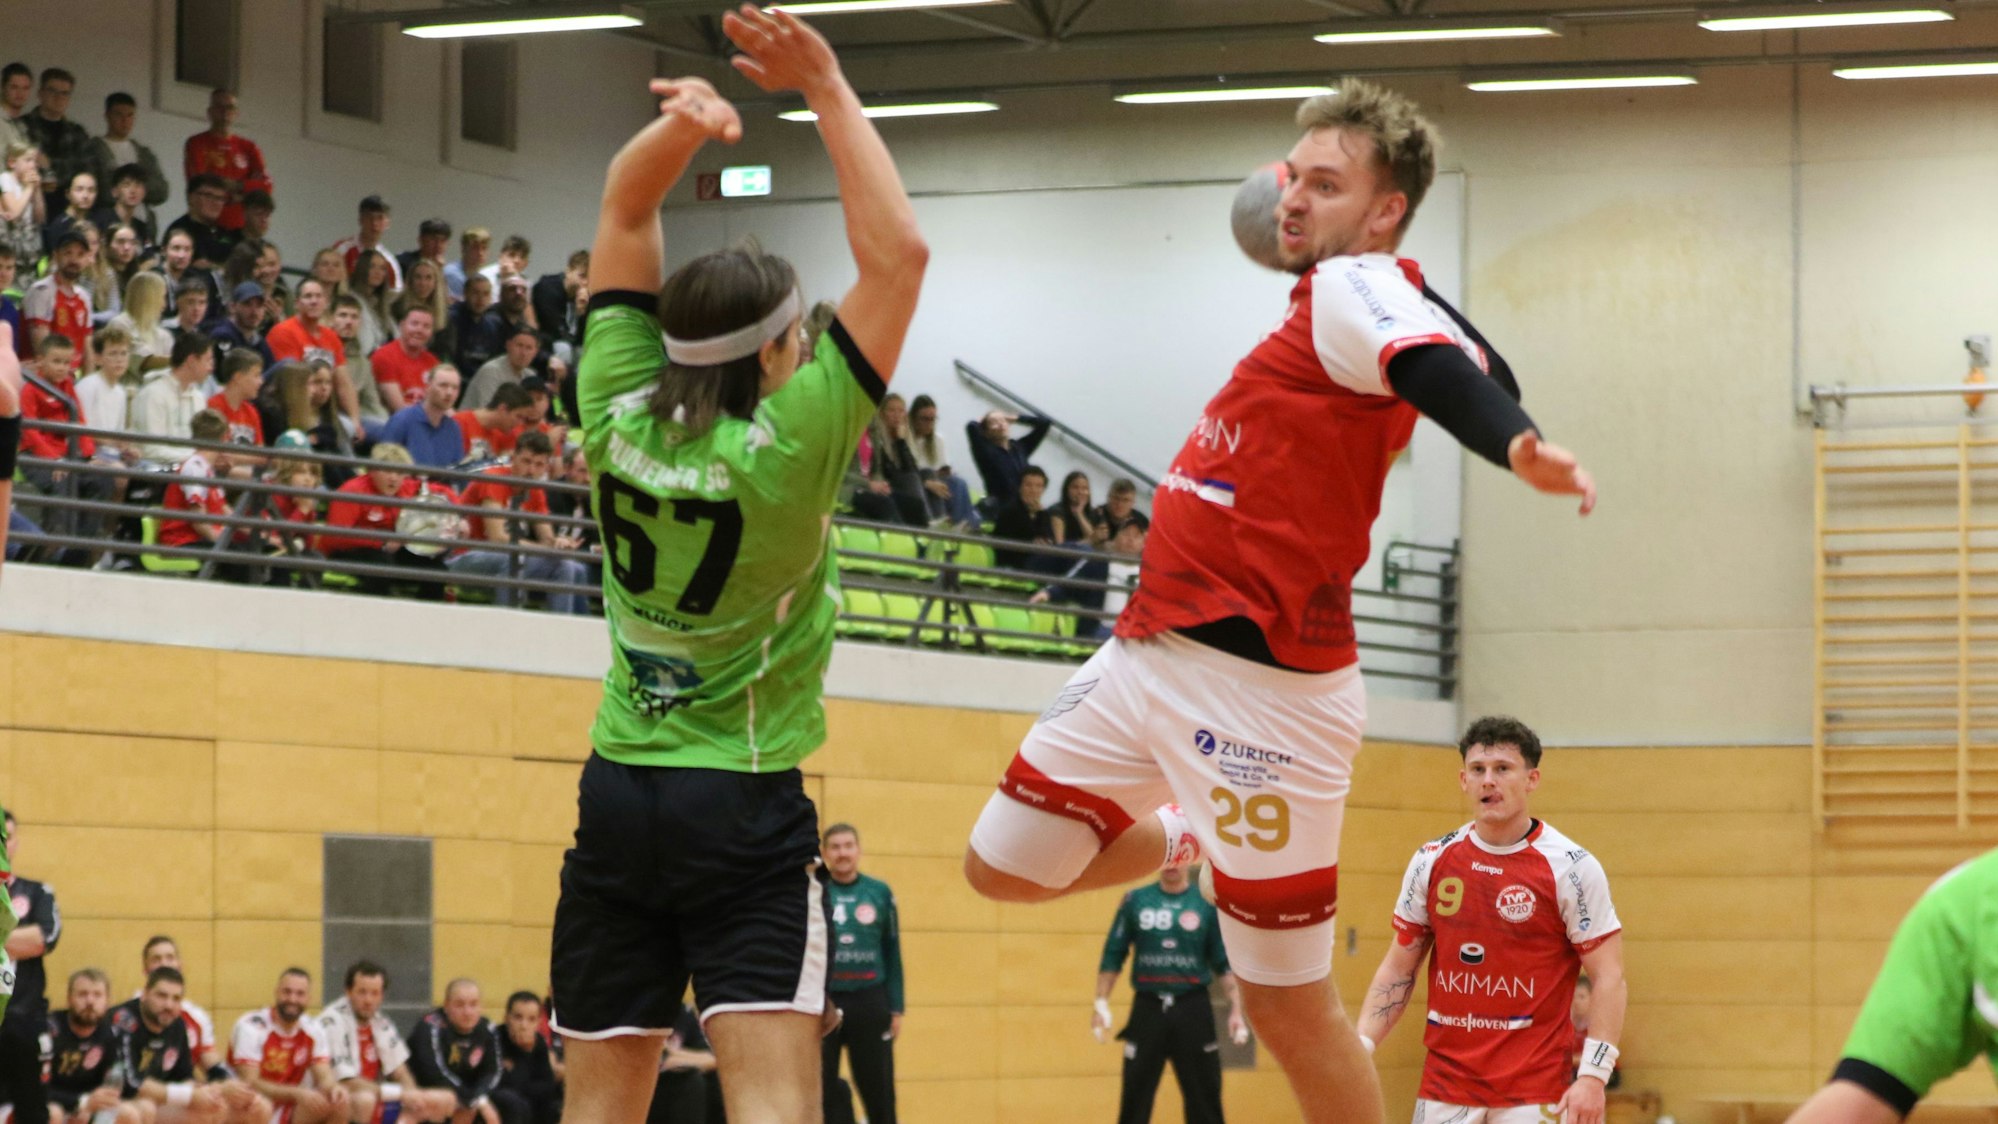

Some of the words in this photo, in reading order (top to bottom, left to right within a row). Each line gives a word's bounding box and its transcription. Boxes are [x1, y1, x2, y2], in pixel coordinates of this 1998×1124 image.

[598, 472, 744, 616] 67
[1220, 741, 1293, 764] ZURICH
[1210, 786, 1290, 852] 29
[1471, 861, 1504, 876] Kempa
[1436, 877, 1464, 916] 9
[1504, 892, 1527, 905] TVP
[1139, 908, 1172, 931] 98
[1279, 912, 1311, 922] Kempa
[1506, 904, 1529, 916] 1920
[1435, 970, 1534, 998] AKIMAN
